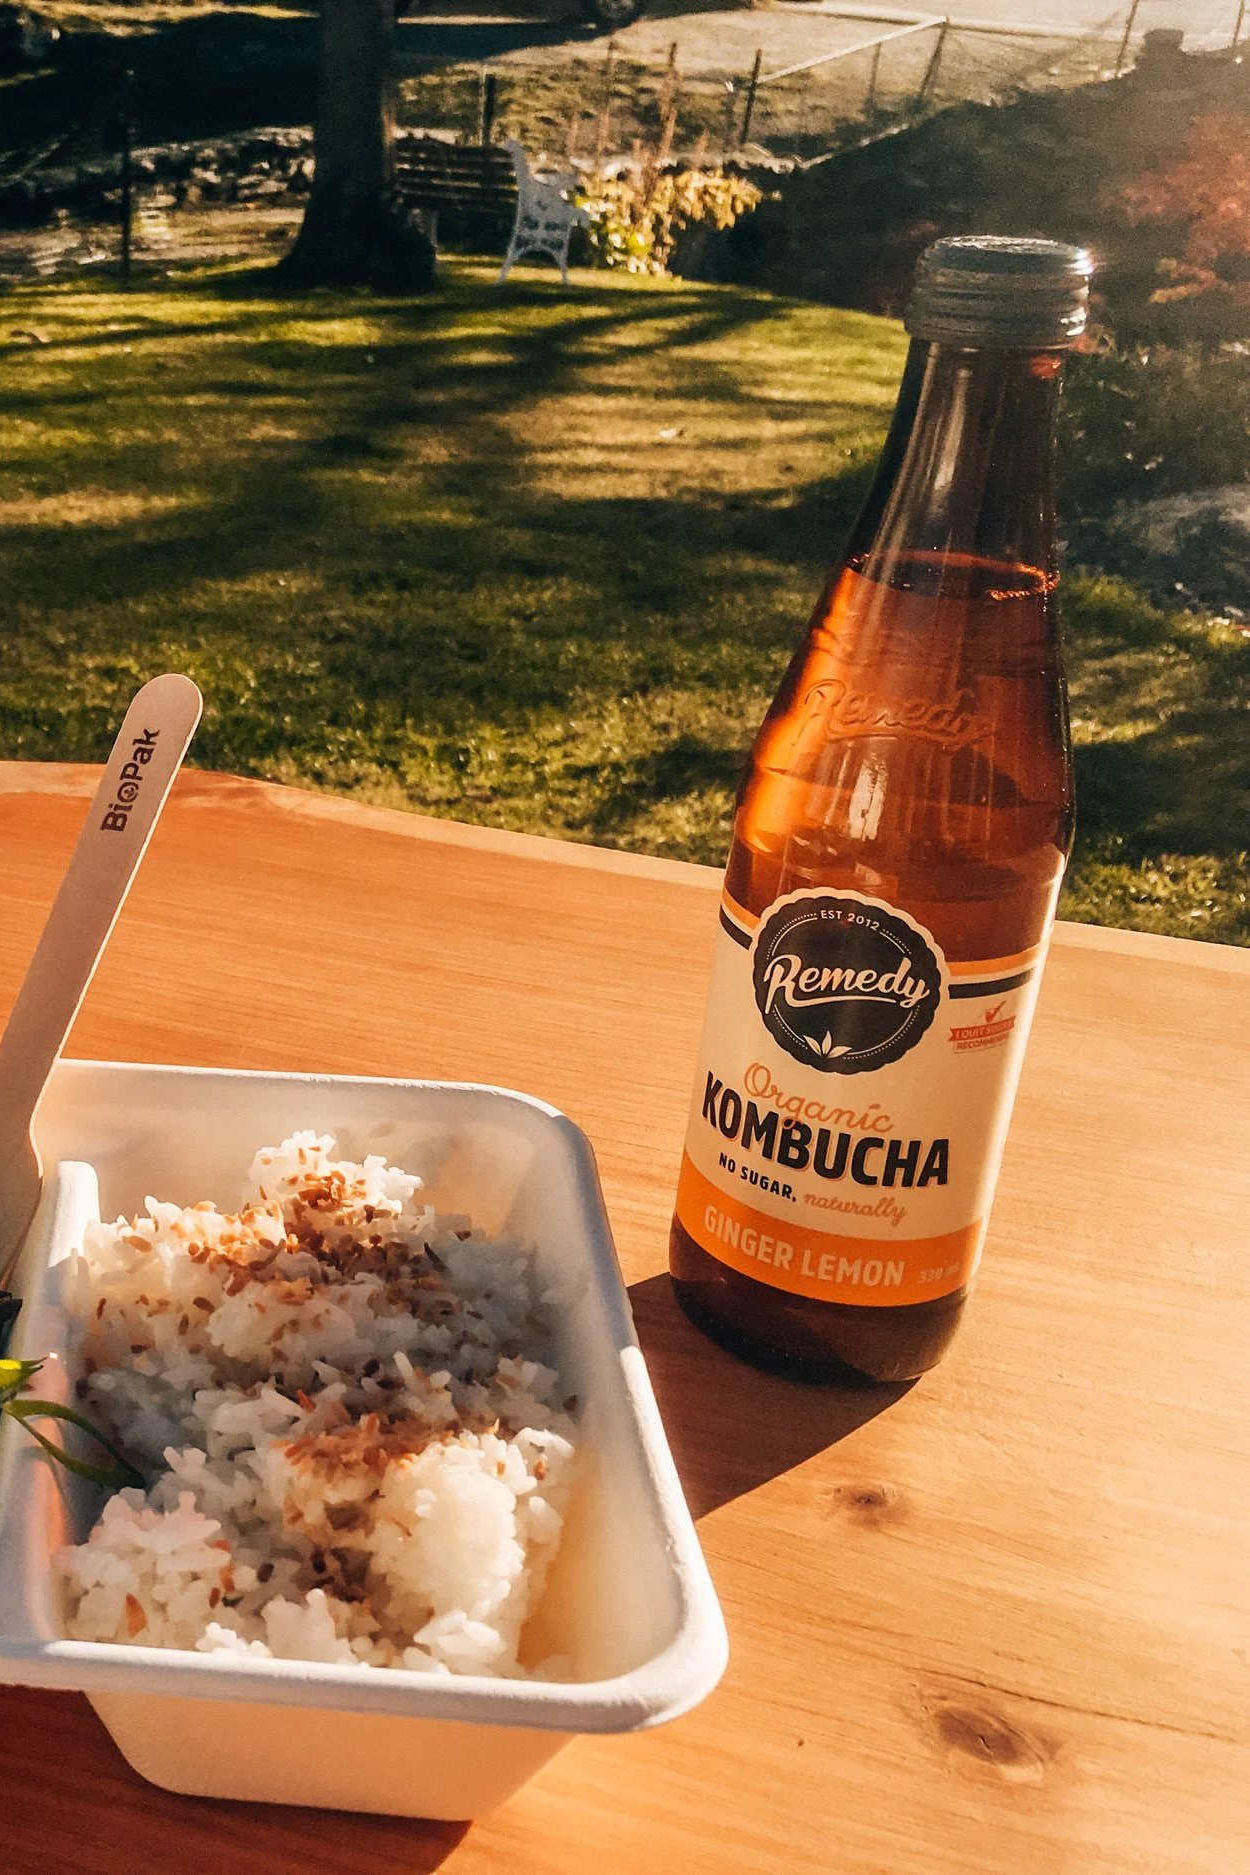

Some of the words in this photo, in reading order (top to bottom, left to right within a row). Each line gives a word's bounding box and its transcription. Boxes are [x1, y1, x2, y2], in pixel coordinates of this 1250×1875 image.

[101, 728, 161, 832] BioPak
[820, 909, 843, 920] EST
[847, 912, 880, 931] 2012
[763, 954, 931, 1014] Remedy
[961, 1027, 985, 1040] QUIT
[702, 1071, 950, 1188] KOMBUCHA
[744, 1062, 894, 1130] Organic
[719, 1152, 736, 1174] NO
[740, 1166, 797, 1202] SUGAR,
[803, 1191, 906, 1227] naturally
[704, 1204, 794, 1271] GINGER
[801, 1249, 906, 1287] LEMON
